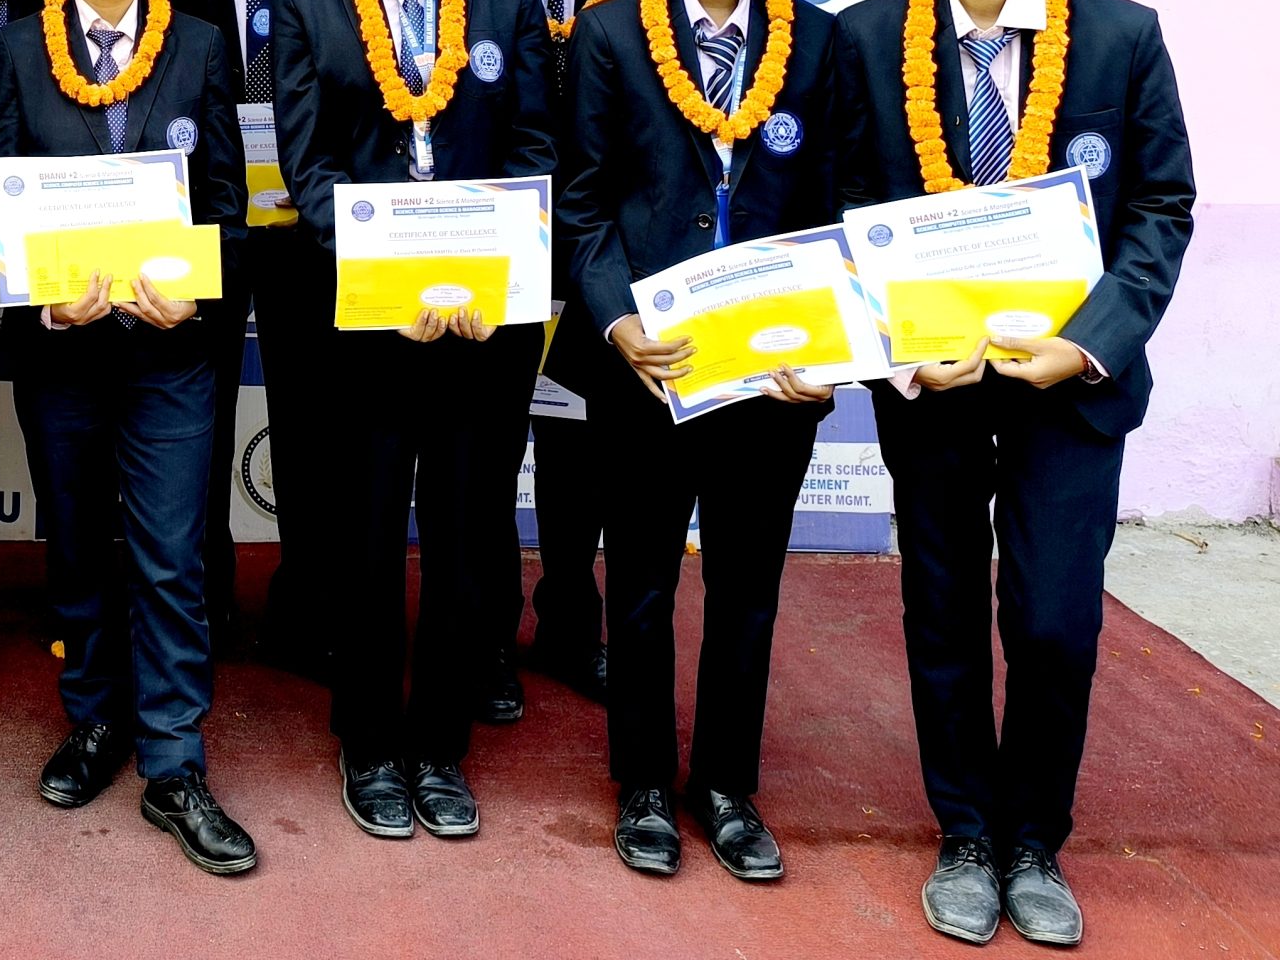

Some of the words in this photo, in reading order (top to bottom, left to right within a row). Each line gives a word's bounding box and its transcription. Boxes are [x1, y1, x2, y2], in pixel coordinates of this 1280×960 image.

[39, 172, 66, 180] BHANU
[391, 198, 421, 206] BHANU
[909, 212, 943, 225] BHANU
[685, 269, 714, 285] BHANU
[836, 465, 885, 475] SCIENCE
[802, 479, 850, 490] GEMENT
[836, 495, 871, 506] MGMT.
